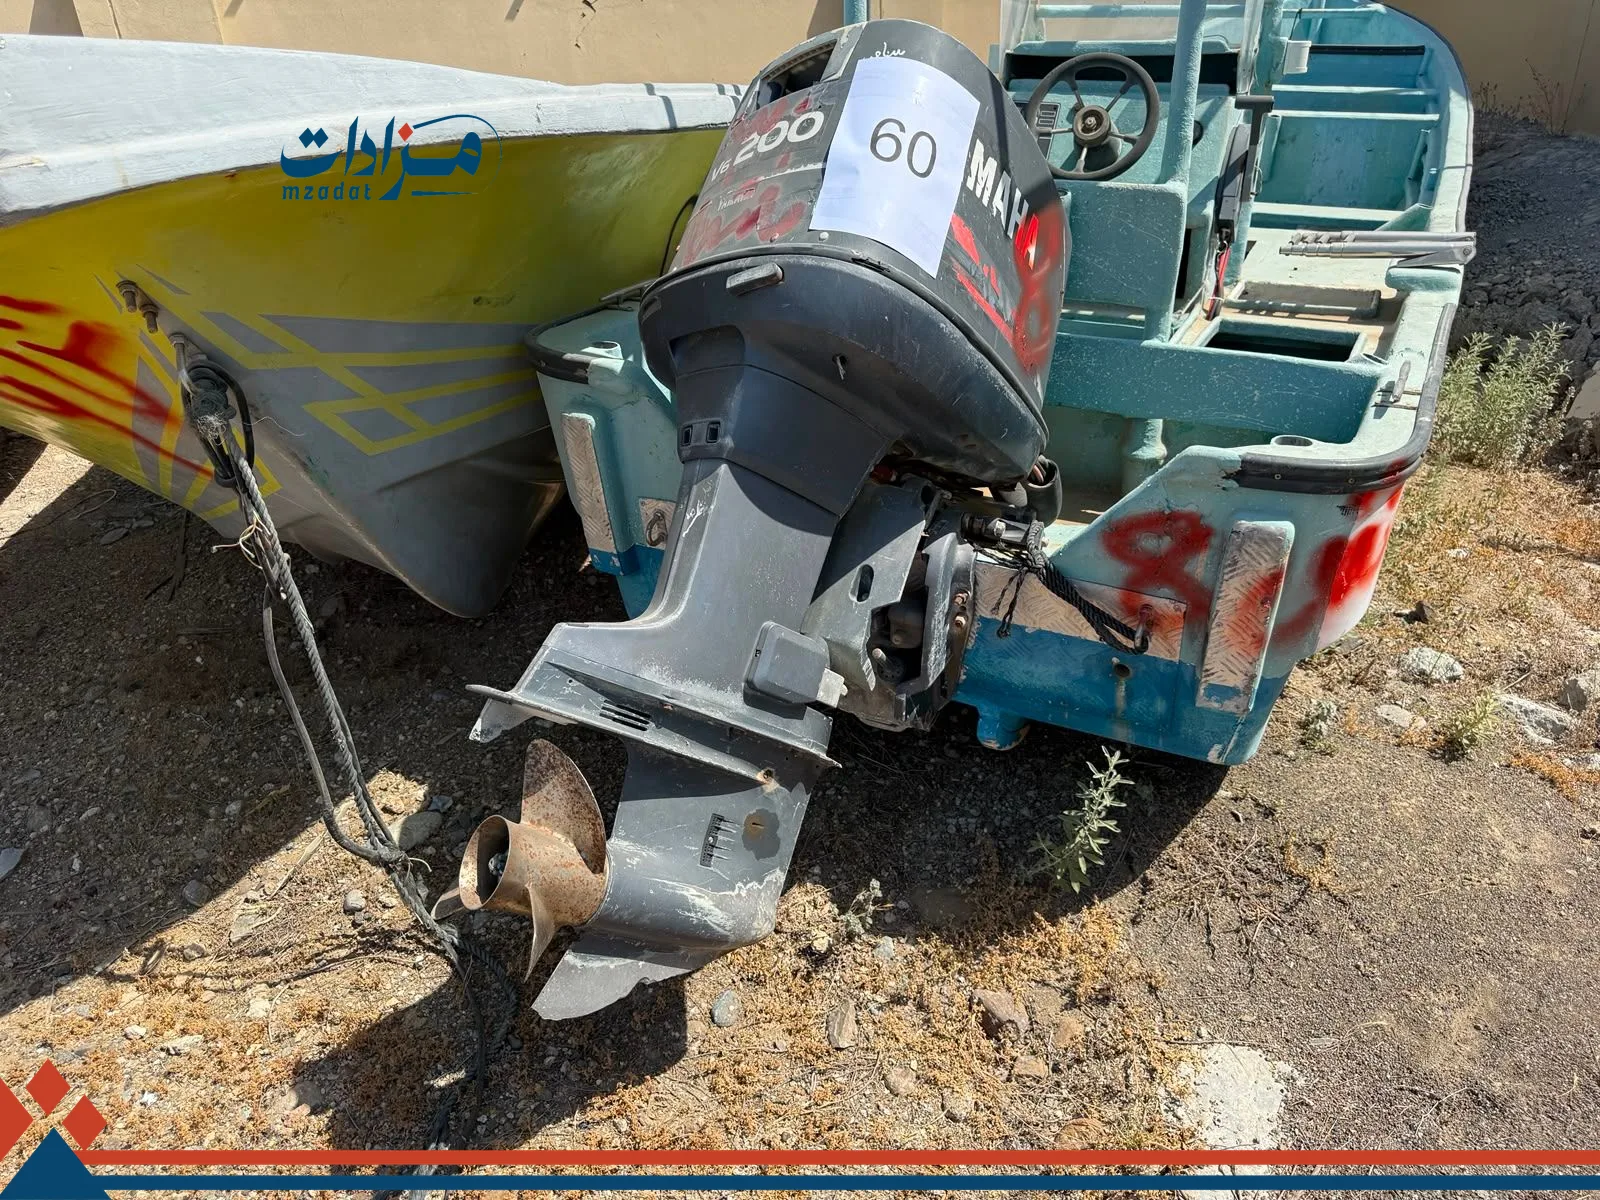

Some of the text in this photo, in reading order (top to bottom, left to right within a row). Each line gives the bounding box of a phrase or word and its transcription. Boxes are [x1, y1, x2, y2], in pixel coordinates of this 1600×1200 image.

[733, 110, 824, 166] 200
[869, 117, 937, 178] 60
[966, 138, 1039, 270] MAHA
